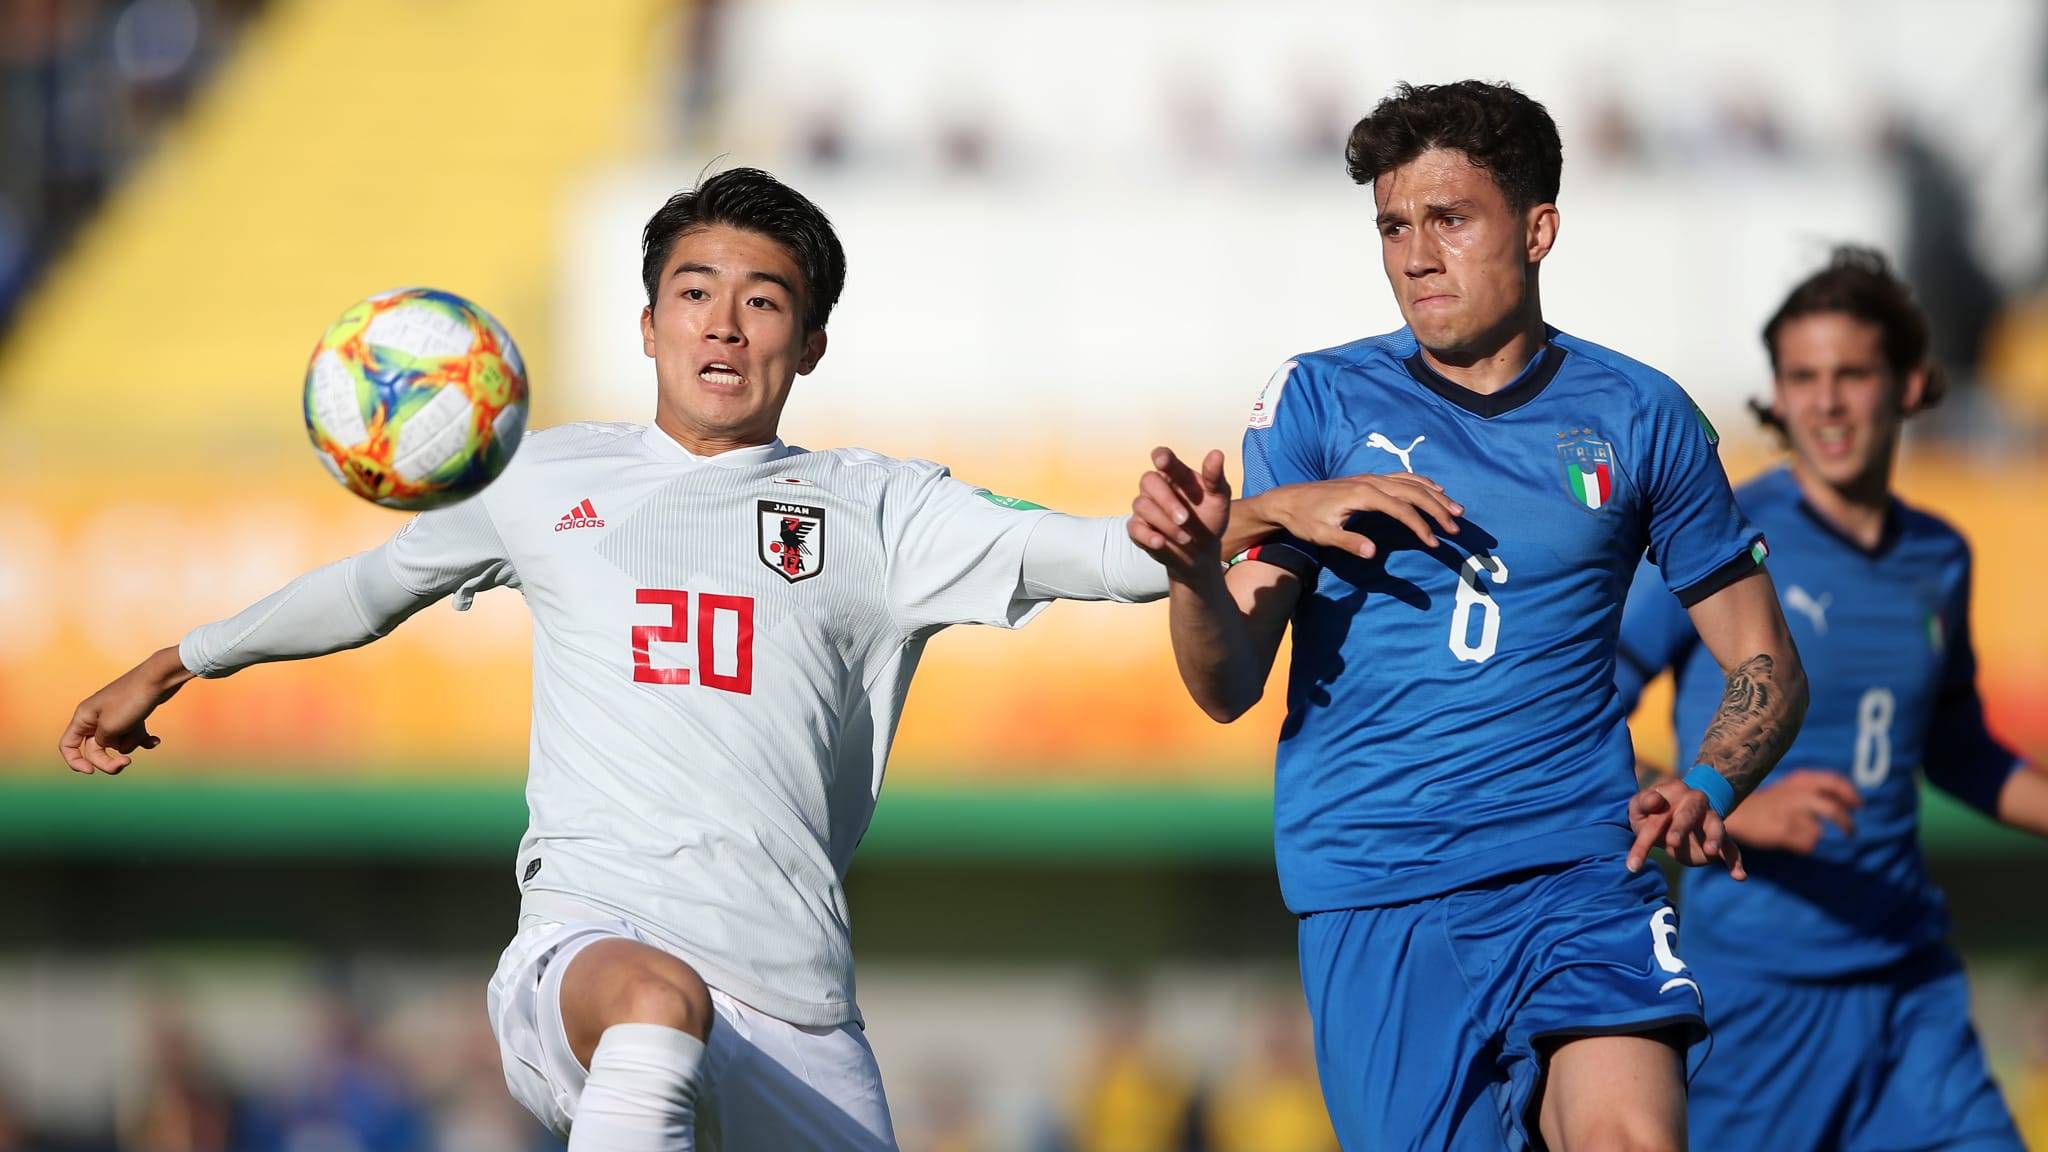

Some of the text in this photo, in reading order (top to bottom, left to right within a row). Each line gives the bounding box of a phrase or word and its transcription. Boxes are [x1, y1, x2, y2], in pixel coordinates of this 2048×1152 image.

[1563, 447, 1607, 458] ITALIA
[773, 504, 810, 515] JAPAN
[554, 517, 606, 532] adidas
[776, 555, 806, 572] JFA
[1449, 554, 1509, 663] 6
[631, 588, 755, 695] 20
[1855, 689, 1894, 788] 8
